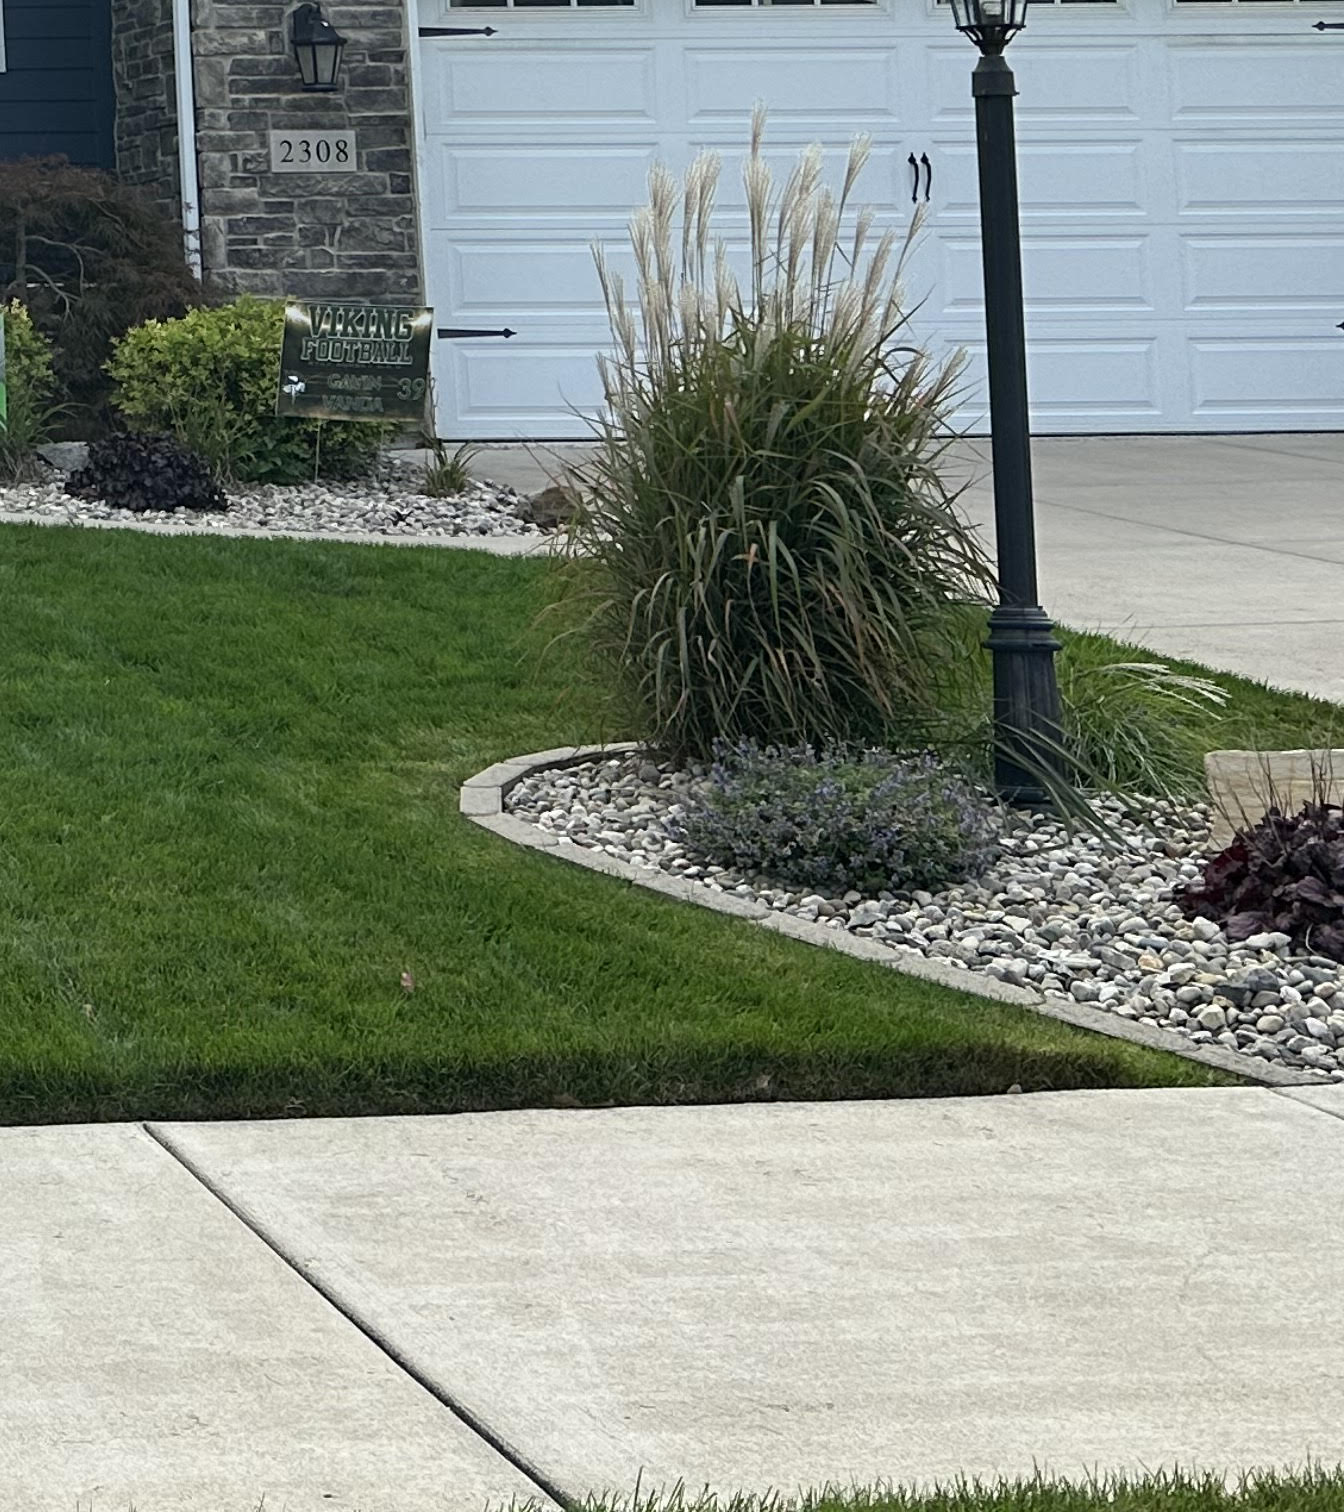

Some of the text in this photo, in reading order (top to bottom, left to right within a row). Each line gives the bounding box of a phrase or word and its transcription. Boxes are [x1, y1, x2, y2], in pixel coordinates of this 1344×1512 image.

[280, 140, 349, 163] 2308
[308, 306, 414, 342] VIKING
[300, 338, 412, 365] FOOTBALL
[396, 377, 425, 401] 39
